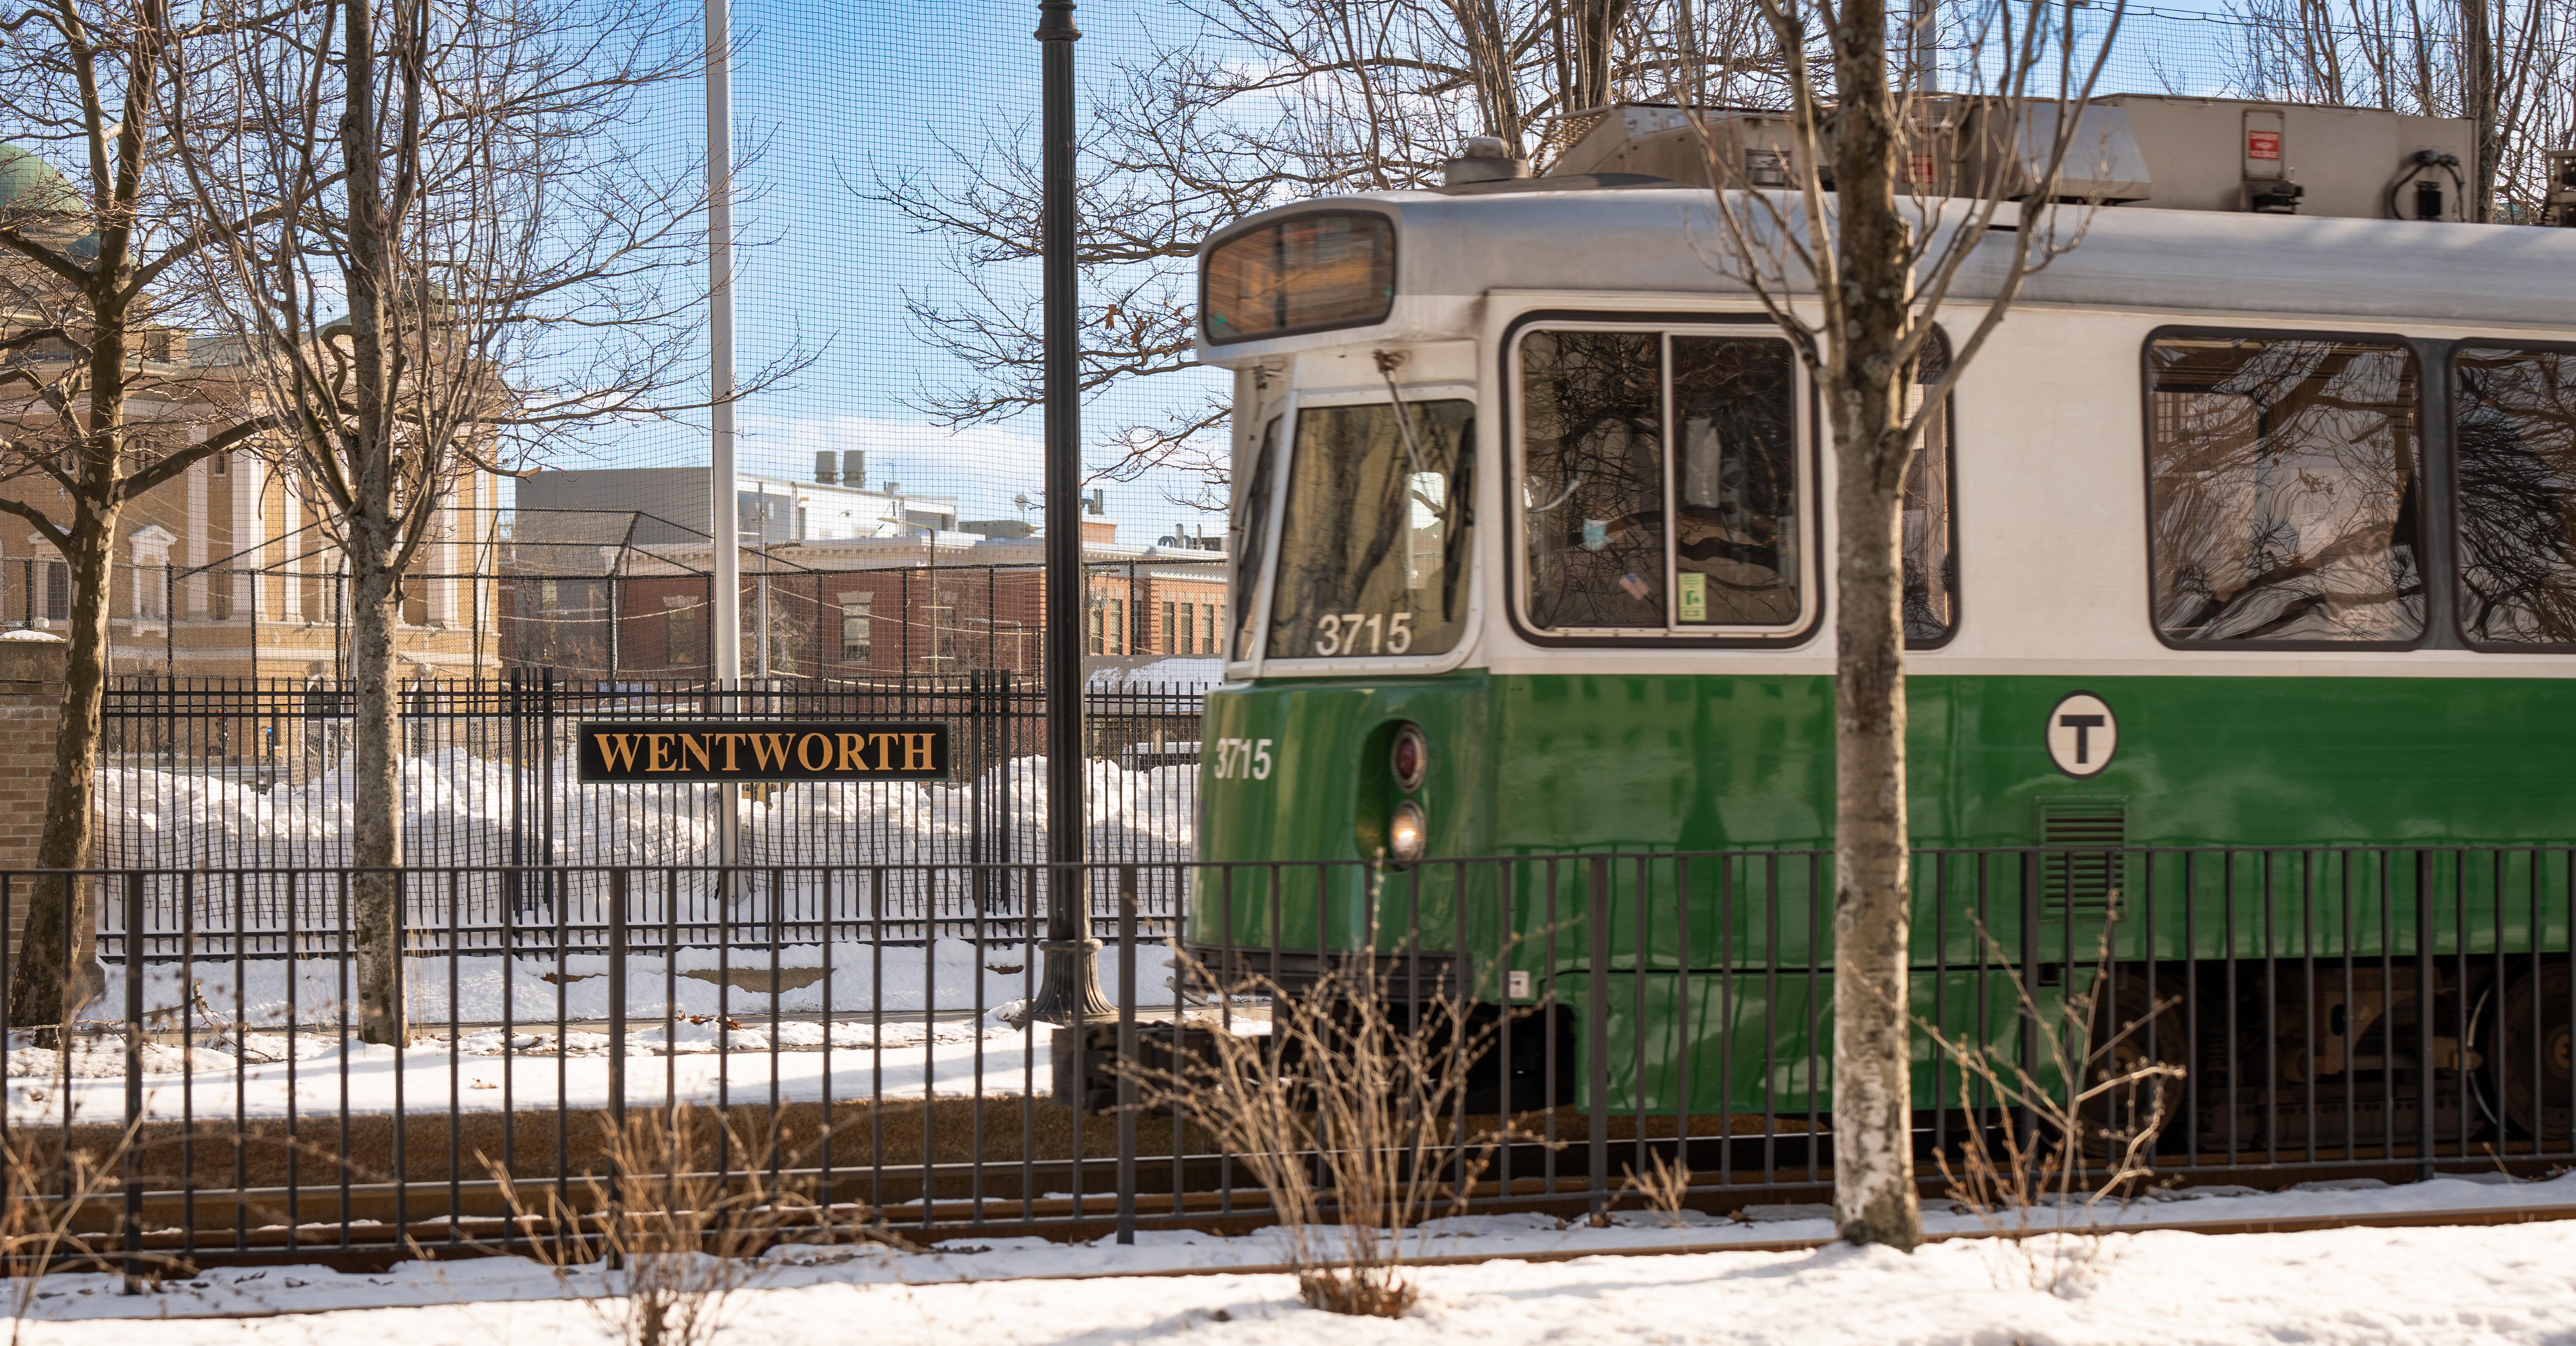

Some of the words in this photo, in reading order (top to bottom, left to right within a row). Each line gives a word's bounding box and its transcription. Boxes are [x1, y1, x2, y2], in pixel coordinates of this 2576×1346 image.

[1316, 613, 1412, 656] 3715
[594, 733, 936, 772] WENTWORTH
[1214, 738, 1273, 780] 3715
[2060, 714, 2105, 764] T
